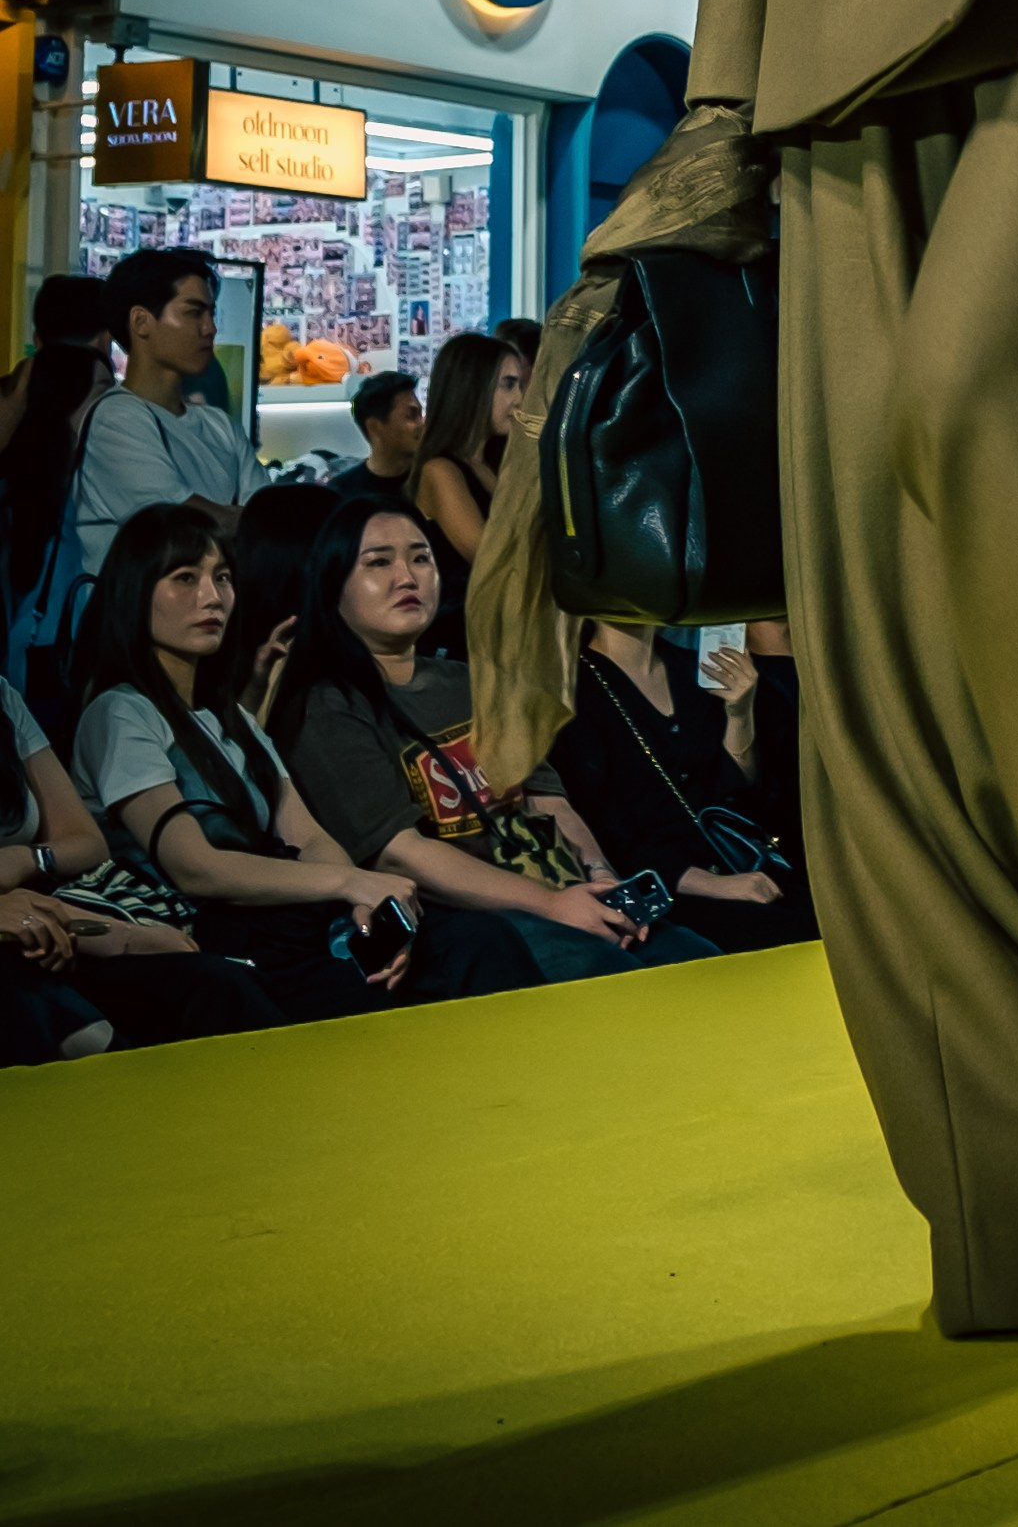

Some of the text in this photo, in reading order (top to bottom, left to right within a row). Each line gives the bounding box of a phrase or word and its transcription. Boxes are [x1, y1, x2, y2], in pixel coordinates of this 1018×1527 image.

[108, 97, 178, 128] VERA
[243, 110, 329, 145] oldmoon
[238, 147, 334, 181] self studio
